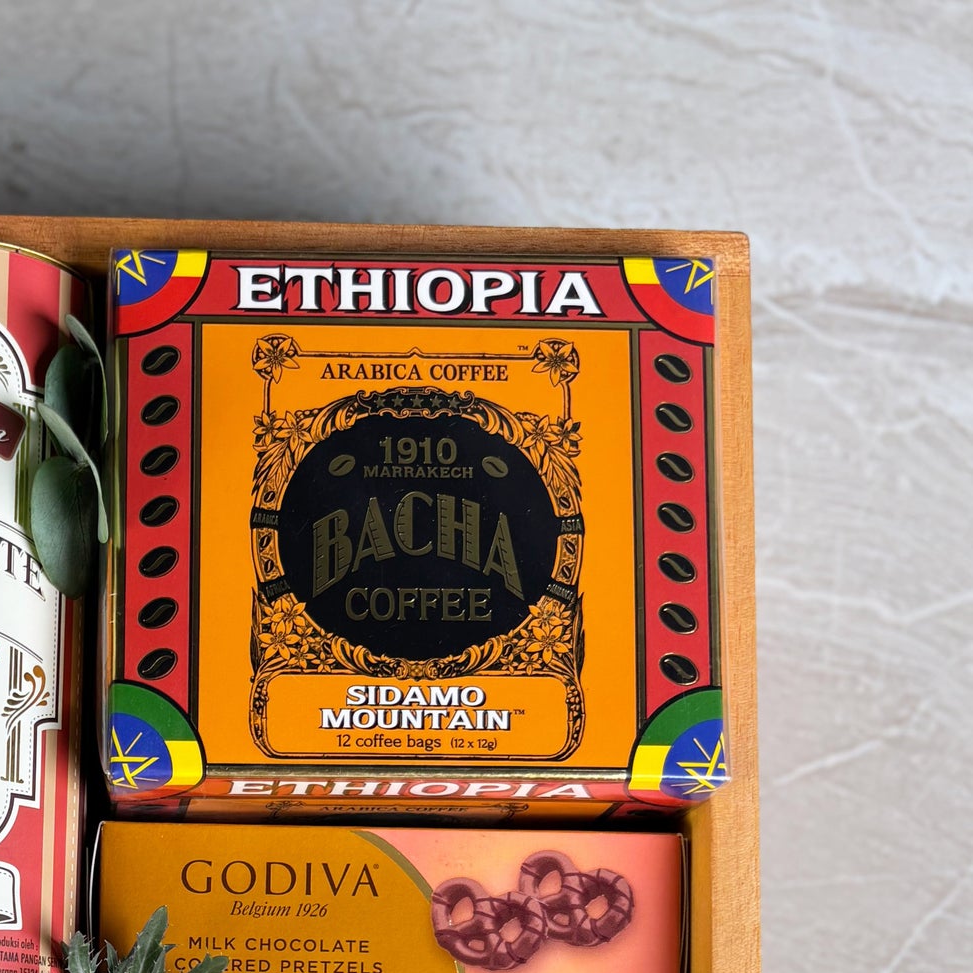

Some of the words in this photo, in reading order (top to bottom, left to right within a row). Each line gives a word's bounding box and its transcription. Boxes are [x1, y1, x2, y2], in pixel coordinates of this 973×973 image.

[229, 265, 607, 317] ETHIOPIA
[320, 363, 422, 380] ARABICA
[430, 364, 508, 381] COFFEE
[379, 436, 457, 464] 1910
[363, 466, 473, 478] MARRAKECH
[312, 491, 525, 600] BACHA
[345, 587, 492, 621] COFFEE
[346, 685, 486, 706] SIDAMO
[319, 708, 511, 730] MOUNTAIN
[336, 735, 350, 747] 12
[356, 734, 402, 748] coffee
[407, 734, 441, 751] bags
[227, 780, 592, 799] ETHIOPIA
[181, 860, 379, 897] GODIVA
[230, 900, 291, 918] Belgium
[296, 903, 328, 917] 1926
[189, 936, 237, 950] MILK
[245, 938, 370, 953] CHOCOLATE
[21, 953, 48, 967] PANGAN
[174, 957, 271, 972] CORED
